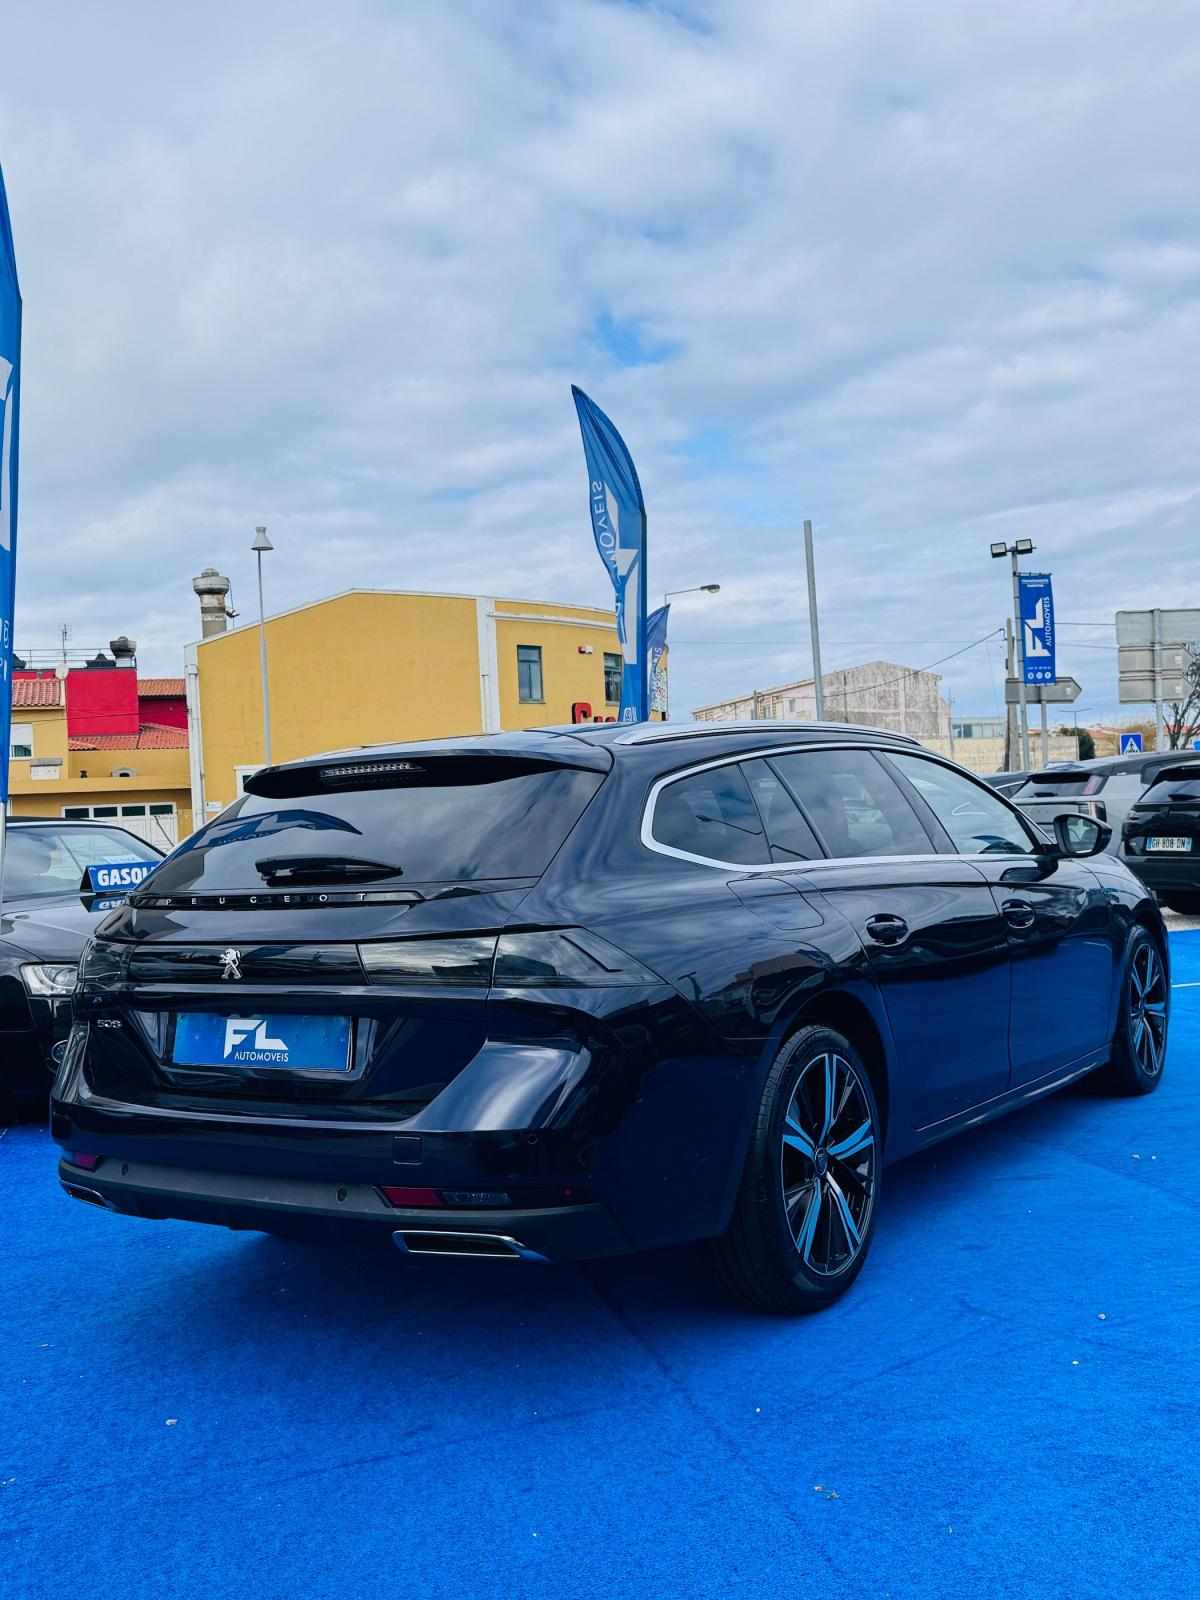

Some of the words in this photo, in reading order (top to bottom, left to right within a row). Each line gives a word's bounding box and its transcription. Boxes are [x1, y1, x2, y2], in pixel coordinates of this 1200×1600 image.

[97, 867, 156, 887] GASOL
[165, 893, 368, 906] PEUGEOT
[224, 1019, 289, 1059] FL
[234, 1050, 289, 1063] AUTOMOVEIS
